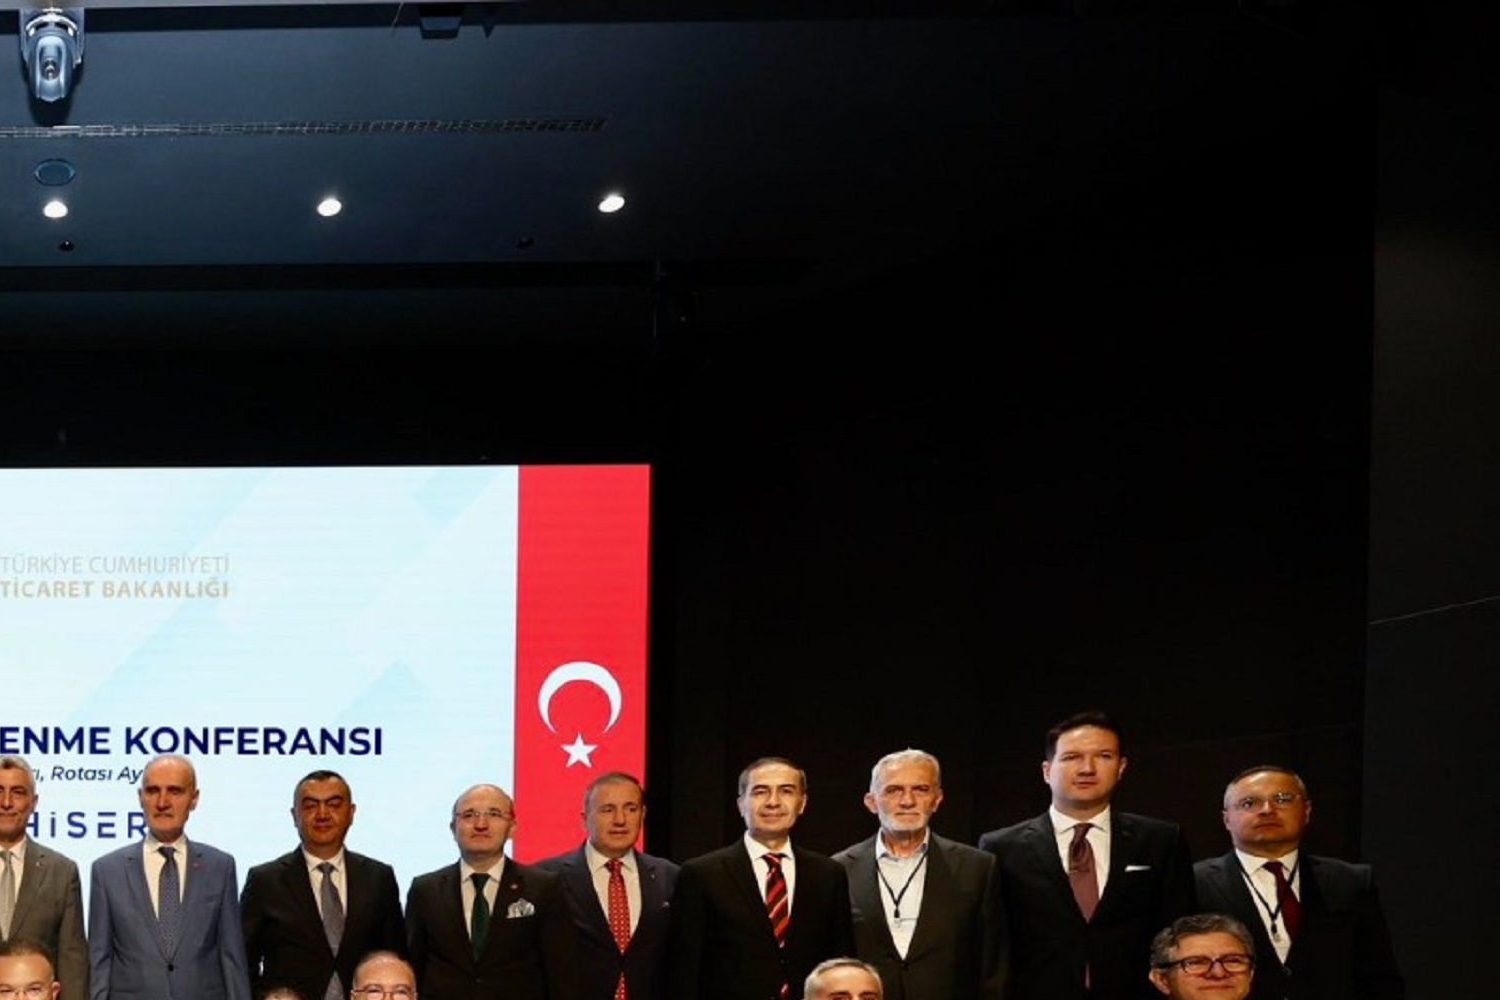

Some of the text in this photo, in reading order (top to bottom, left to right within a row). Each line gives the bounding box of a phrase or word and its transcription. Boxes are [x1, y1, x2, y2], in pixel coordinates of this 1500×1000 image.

[0, 552, 229, 574] TÜRKİYE CUMHURİYETİ
[0, 576, 228, 598] TİCARET BAKANLIĞI
[125, 726, 382, 755] KONFERANSI
[51, 766, 113, 780] Rotası
[117, 766, 143, 784] Ay
